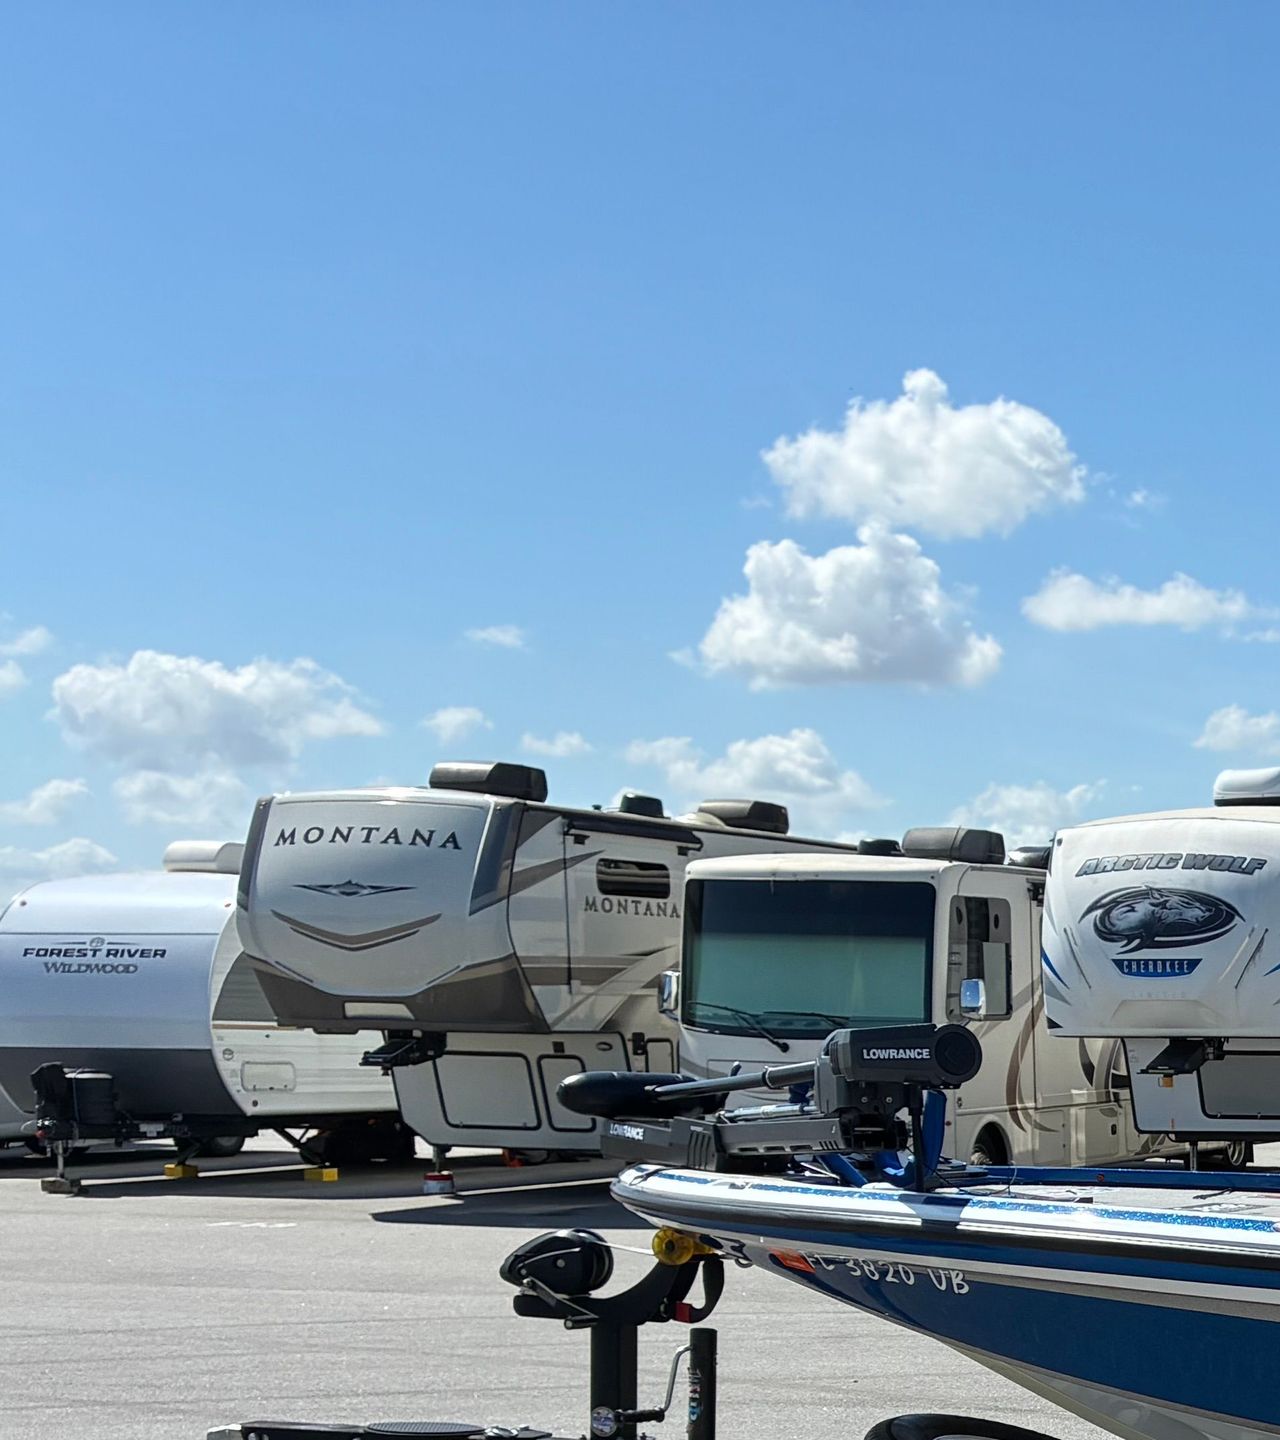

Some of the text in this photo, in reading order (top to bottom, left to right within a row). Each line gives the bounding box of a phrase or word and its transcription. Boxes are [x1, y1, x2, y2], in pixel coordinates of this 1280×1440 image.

[273, 826, 463, 850] MONTANA
[1074, 852, 1269, 878] ARCTIC WOLF
[583, 895, 681, 919] MONTANA
[22, 947, 167, 959] FOREST RIVER
[42, 961, 139, 975] WILDWOOD
[1123, 959, 1190, 974] CHEROKEE
[862, 1048, 932, 1060] LOWRANCE
[844, 1256, 916, 1286] 3820
[927, 1267, 970, 1295] UB
